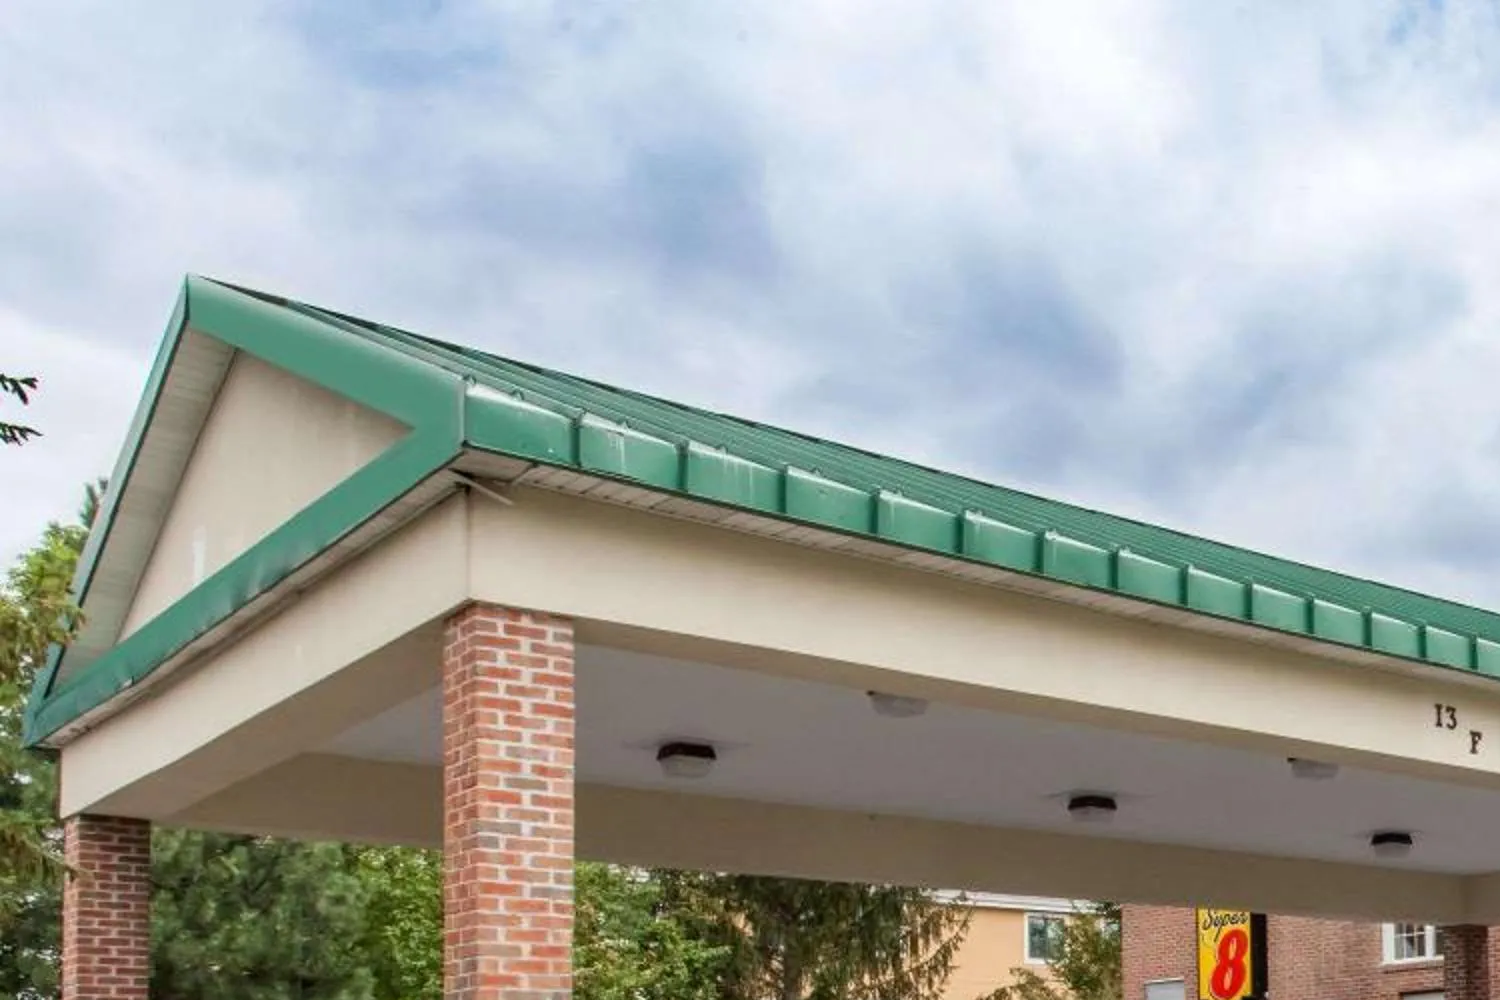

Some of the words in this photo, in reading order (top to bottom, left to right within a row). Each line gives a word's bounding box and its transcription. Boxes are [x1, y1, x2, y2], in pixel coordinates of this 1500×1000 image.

[1434, 703, 1457, 730] 13
[1201, 908, 1248, 942] Super
[1210, 929, 1249, 1000] 8
